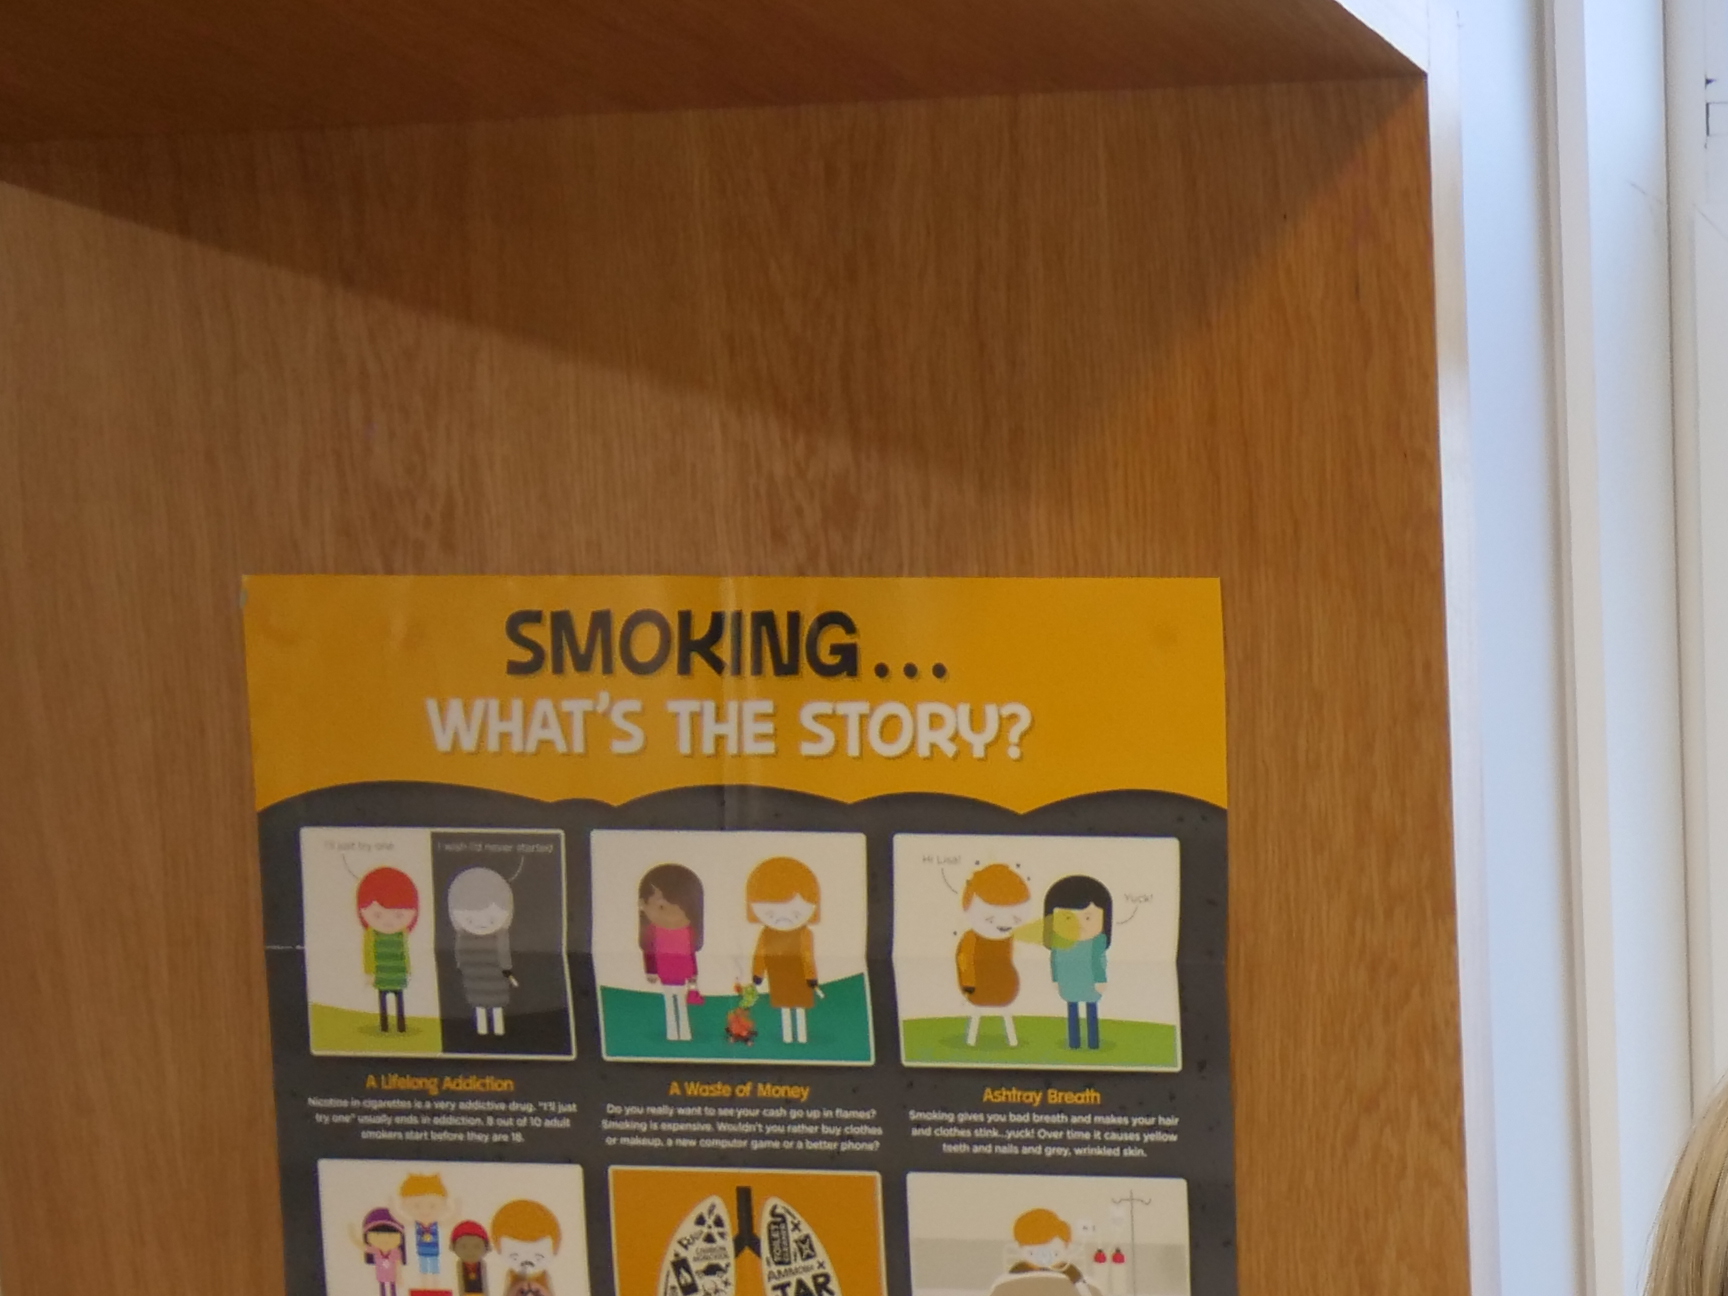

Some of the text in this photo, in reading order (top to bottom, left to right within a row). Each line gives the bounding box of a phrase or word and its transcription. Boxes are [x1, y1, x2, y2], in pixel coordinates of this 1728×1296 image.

[504, 608, 949, 679] SMOKING...
[427, 691, 1034, 760] WHAT'S THE STORY?
[366, 1074, 515, 1095] A Lifelong Addiction
[669, 1081, 810, 1102] A Waste of Money
[982, 1087, 1101, 1107] Ashtray Breath
[909, 1110, 1179, 1127] Smoking gives you bad breath and makes your hair
[911, 1127, 931, 1136] and
[934, 1127, 972, 1137] clothes
[1037, 1129, 1063, 1139] Over
[1066, 1129, 1091, 1140] time
[1104, 1131, 1140, 1142] causes
[1143, 1132, 1178, 1144] yellow
[942, 1142, 970, 1153] teeth
[972, 1143, 992, 1153] and
[995, 1144, 1019, 1154] nails
[1022, 1144, 1042, 1155] and
